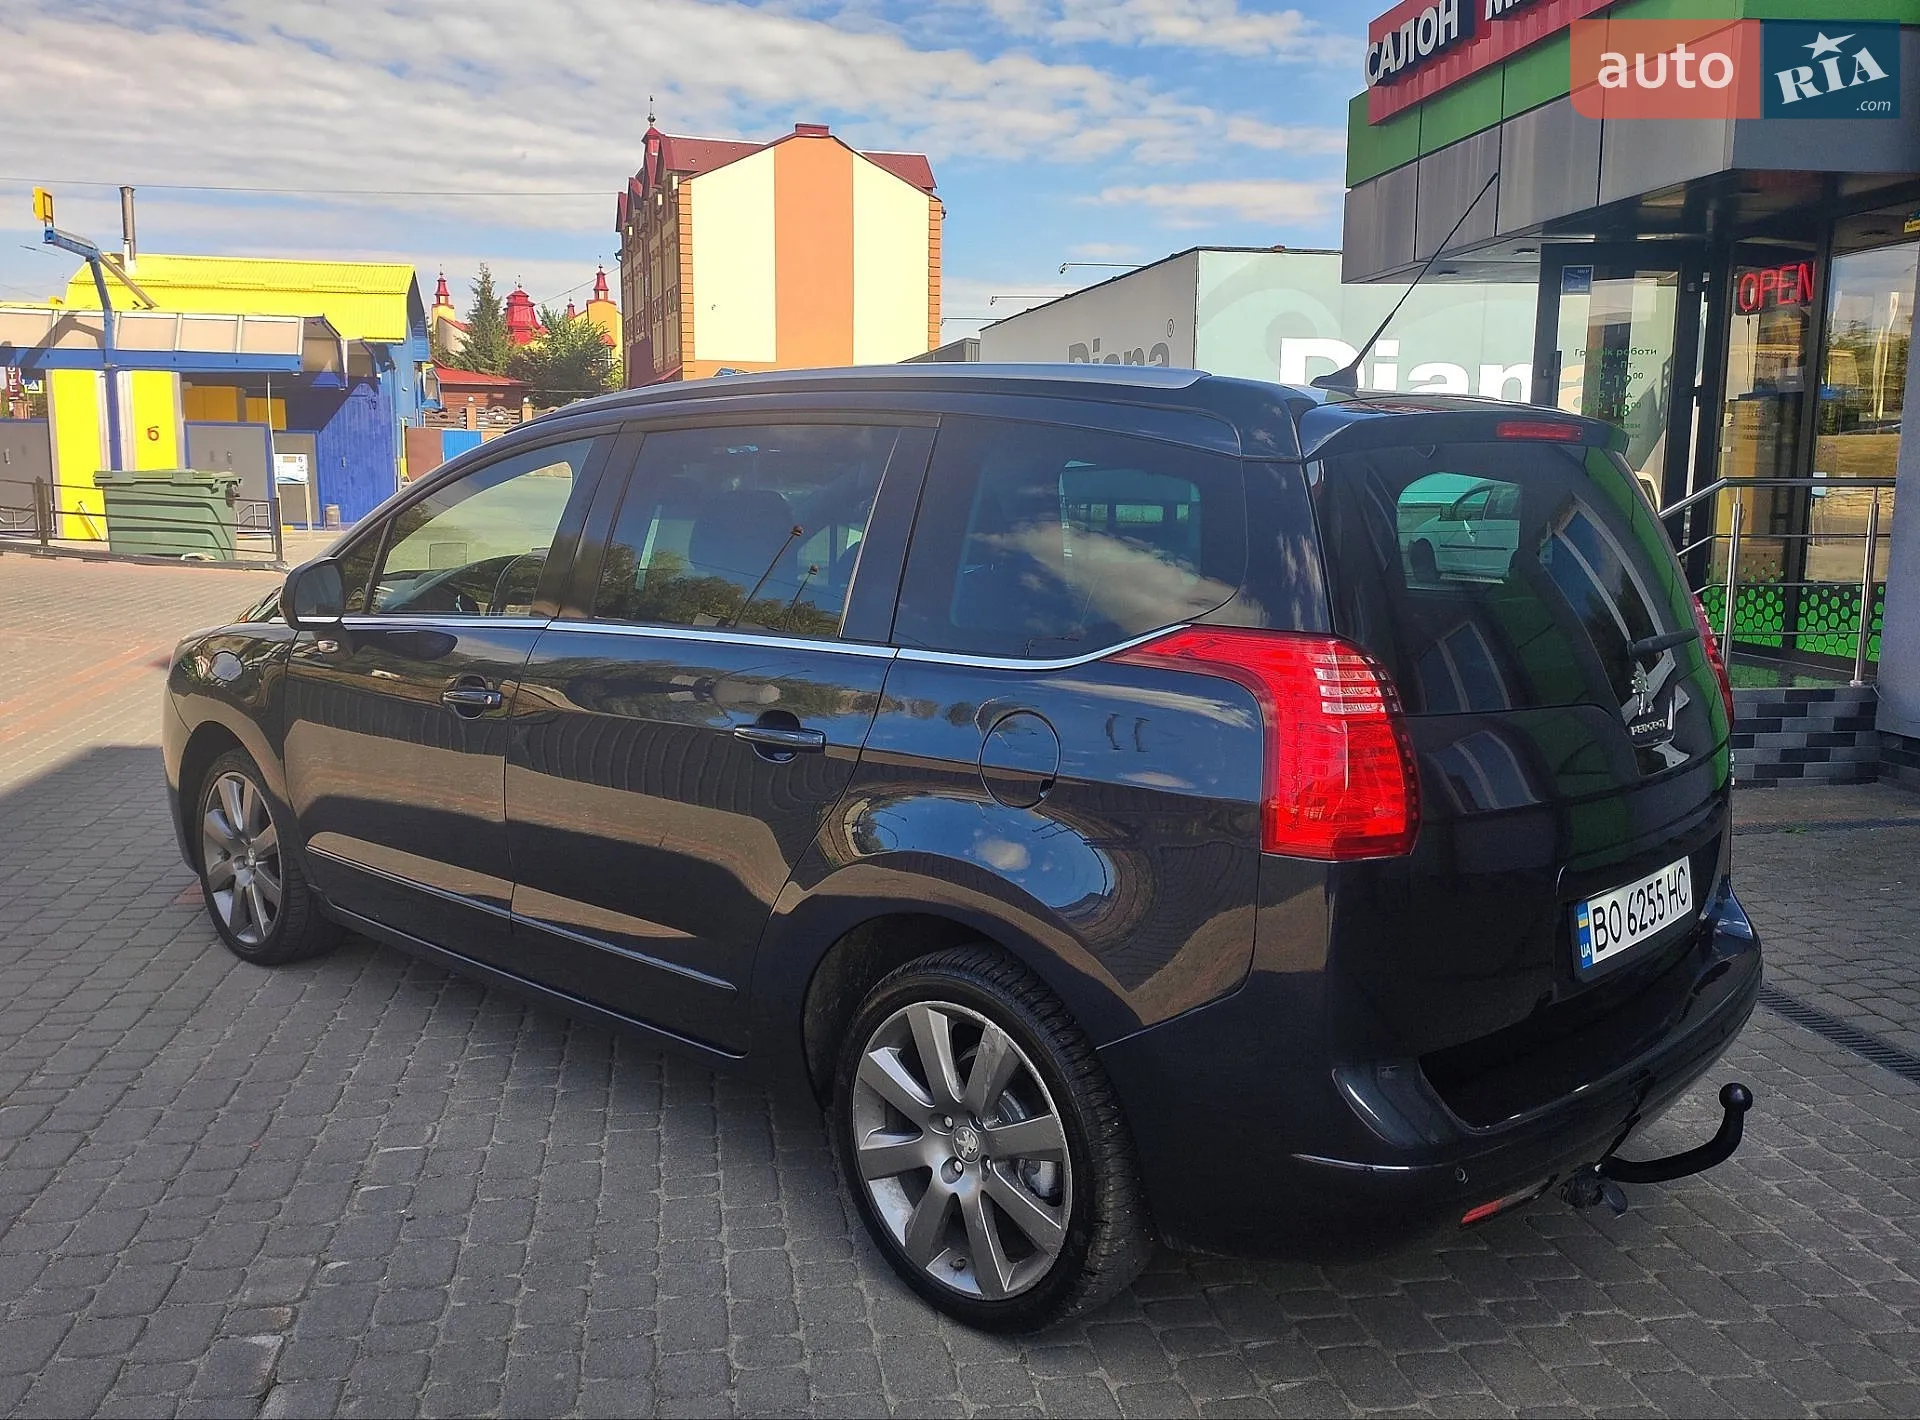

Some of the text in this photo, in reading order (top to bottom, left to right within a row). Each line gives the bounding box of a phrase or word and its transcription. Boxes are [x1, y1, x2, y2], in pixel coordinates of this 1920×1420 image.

[1364, 0, 1459, 87] САЛОН
[1738, 262, 1816, 311] OPEN
[1574, 347, 1657, 357] Грік роботи
[1591, 865, 1688, 953] BO 6255 HC
[1580, 942, 1592, 959] UA
